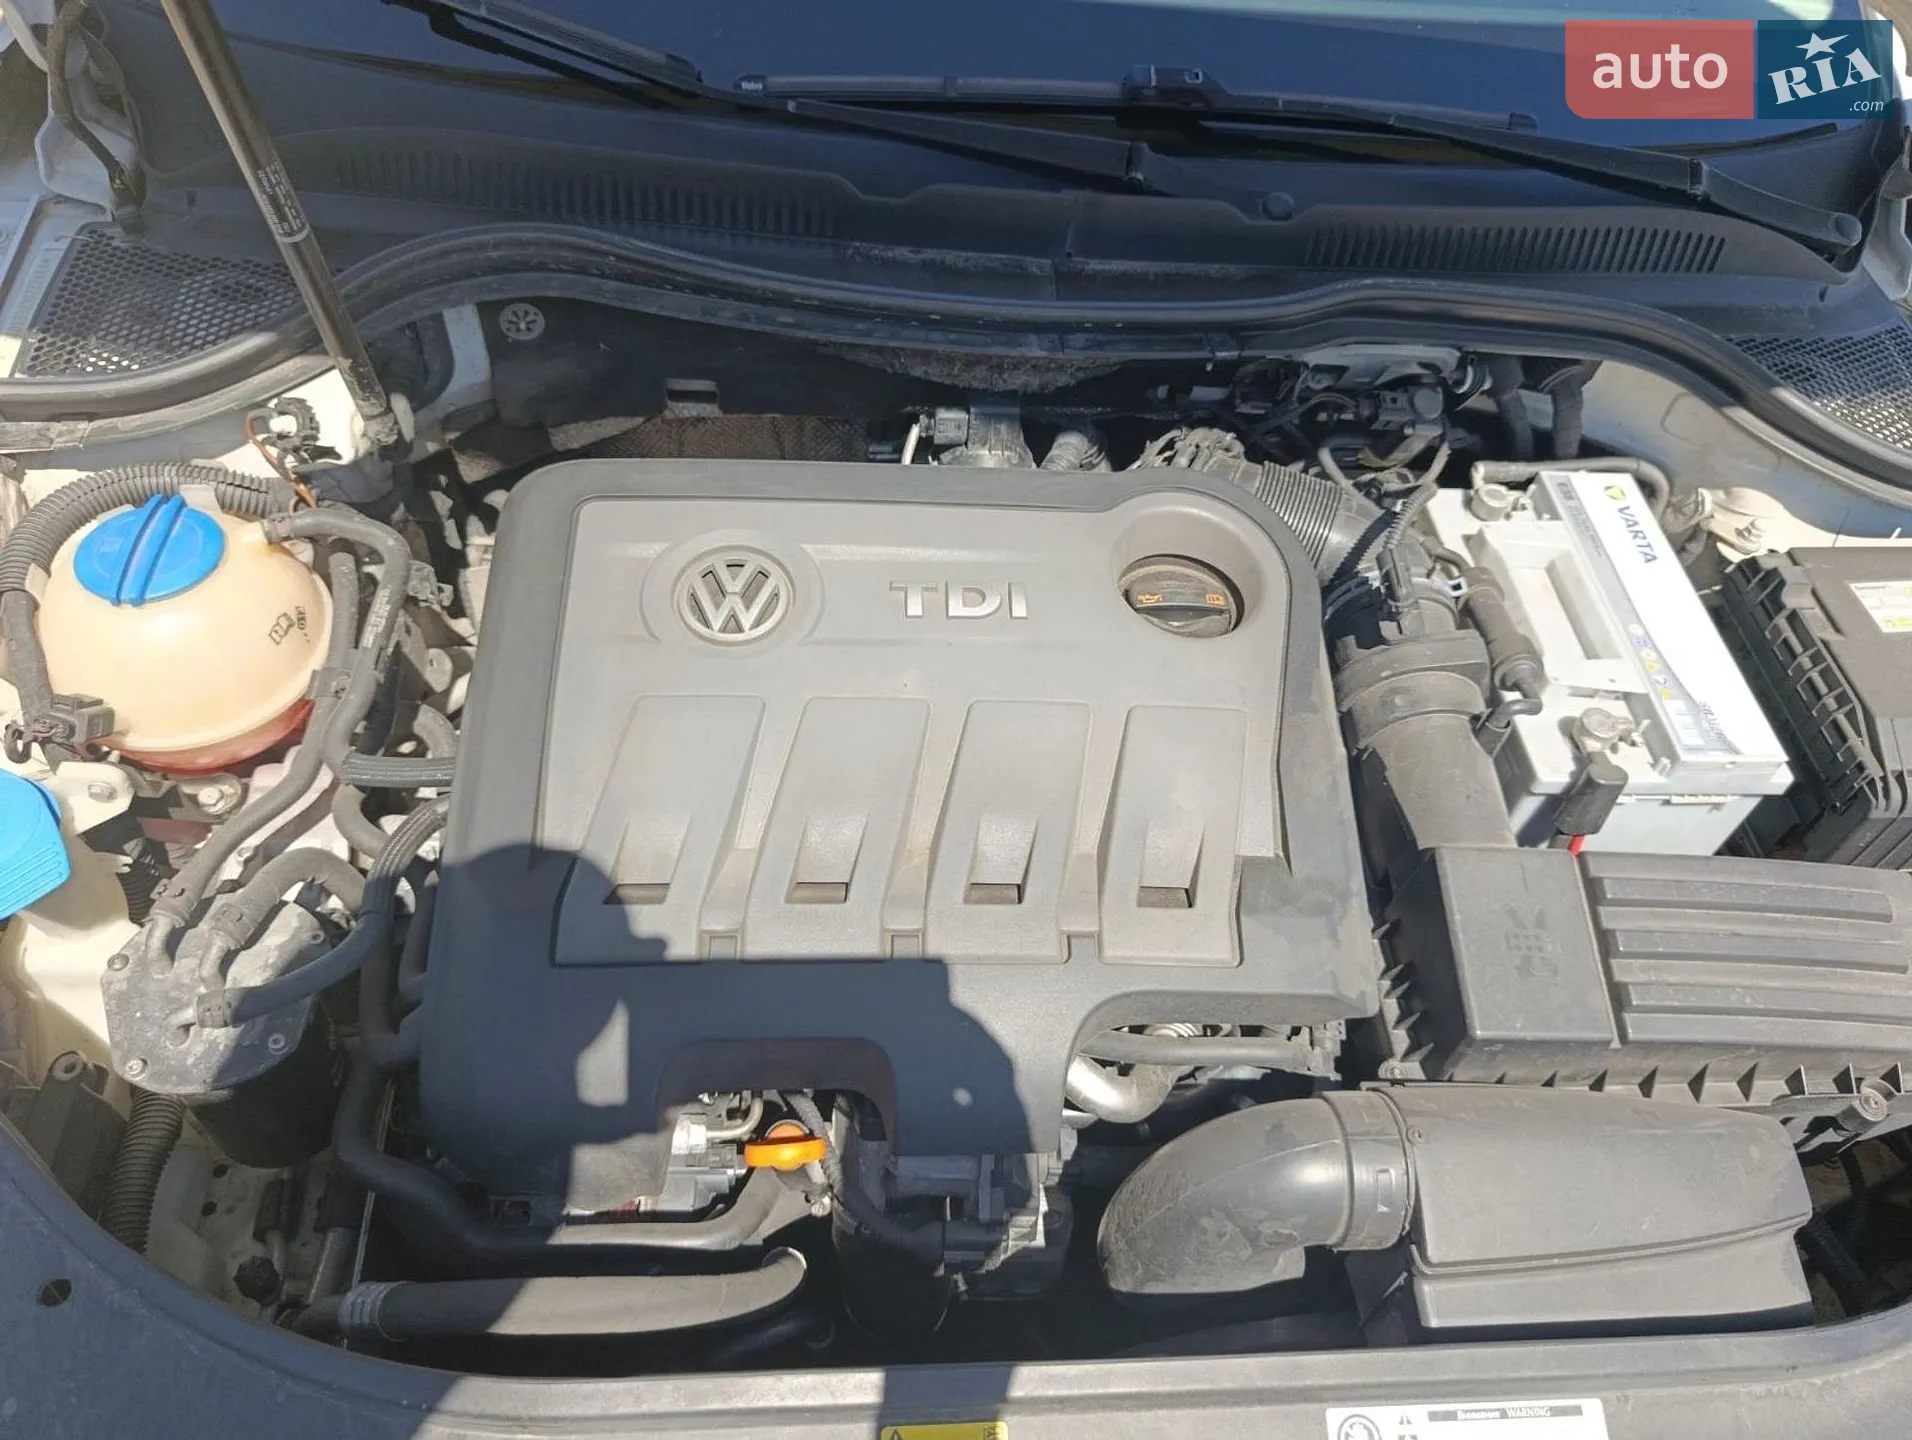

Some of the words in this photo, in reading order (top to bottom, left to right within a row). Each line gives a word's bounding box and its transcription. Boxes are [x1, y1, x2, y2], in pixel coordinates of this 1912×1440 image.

[1617, 505, 1659, 564] VARTA
[683, 552, 788, 640] VW
[888, 581, 1029, 620] TDI
